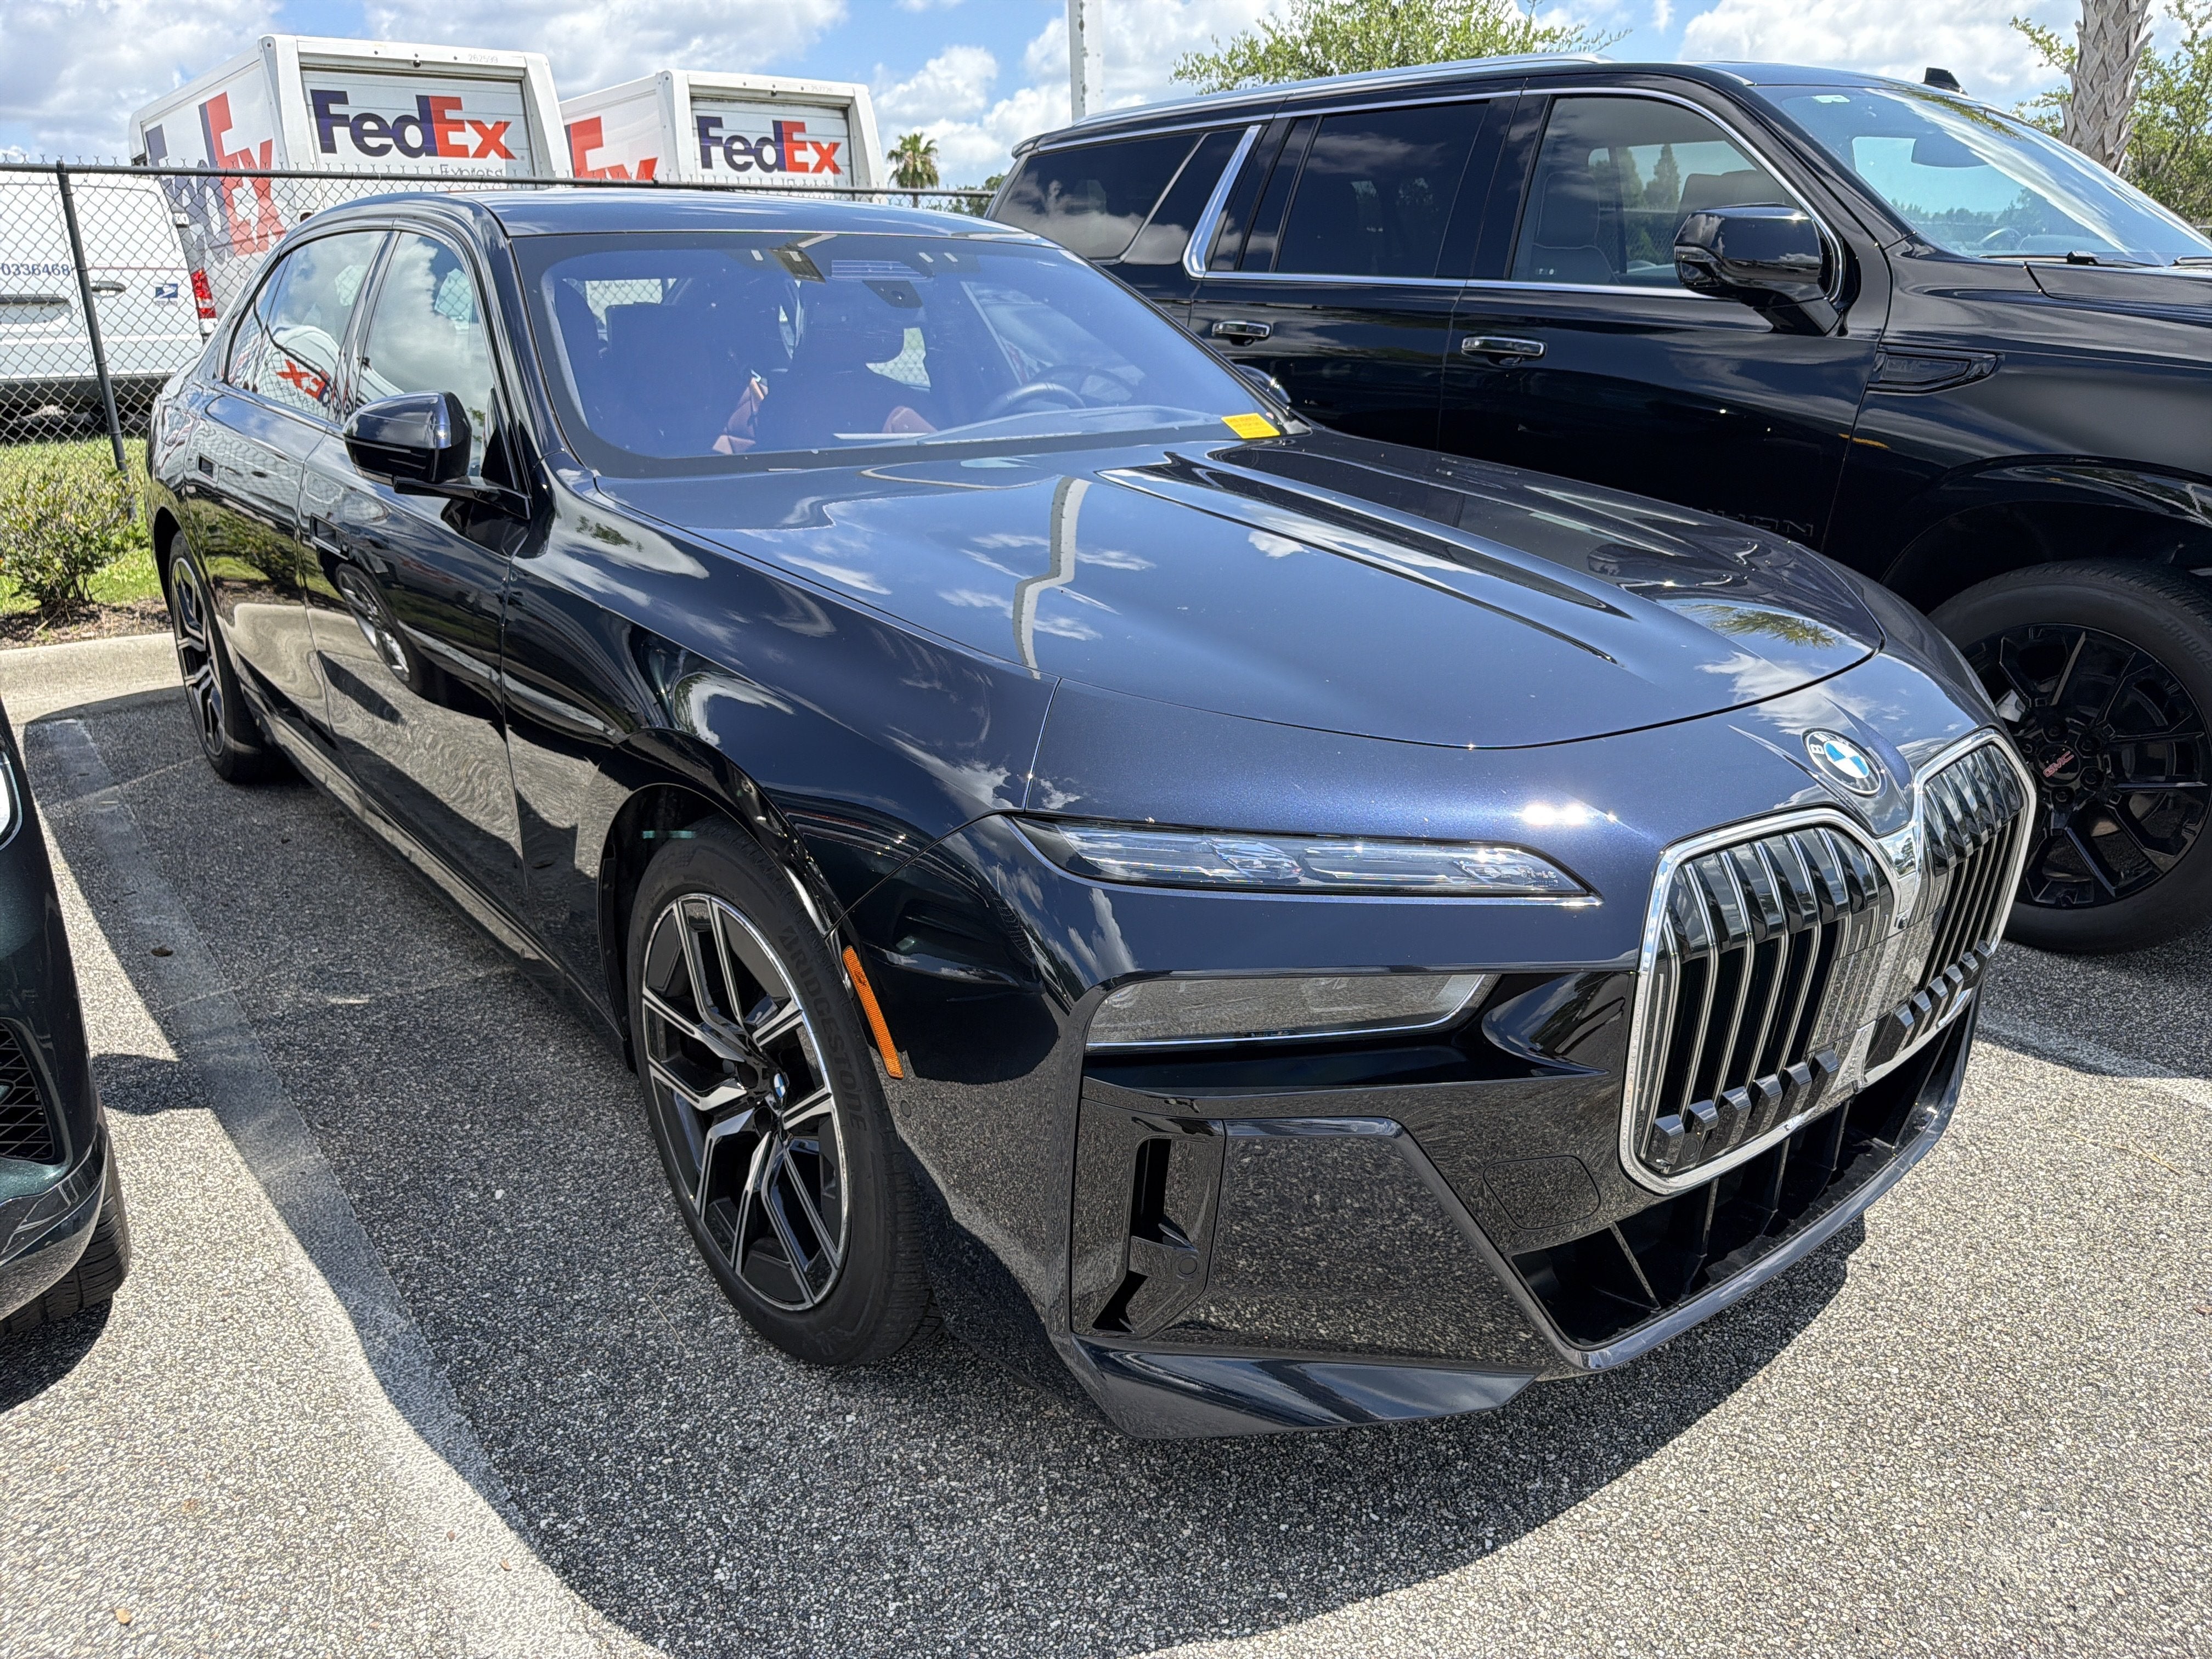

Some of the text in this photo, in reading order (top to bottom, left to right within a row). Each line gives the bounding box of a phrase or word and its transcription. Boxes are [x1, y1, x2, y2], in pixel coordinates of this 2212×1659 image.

[310, 89, 517, 159] FedEx
[695, 115, 843, 174] FedEx
[1, 263, 71, 275] 0336468
[2042, 750, 2074, 777] GMC
[778, 926, 867, 1132] BRIDGESTONE
